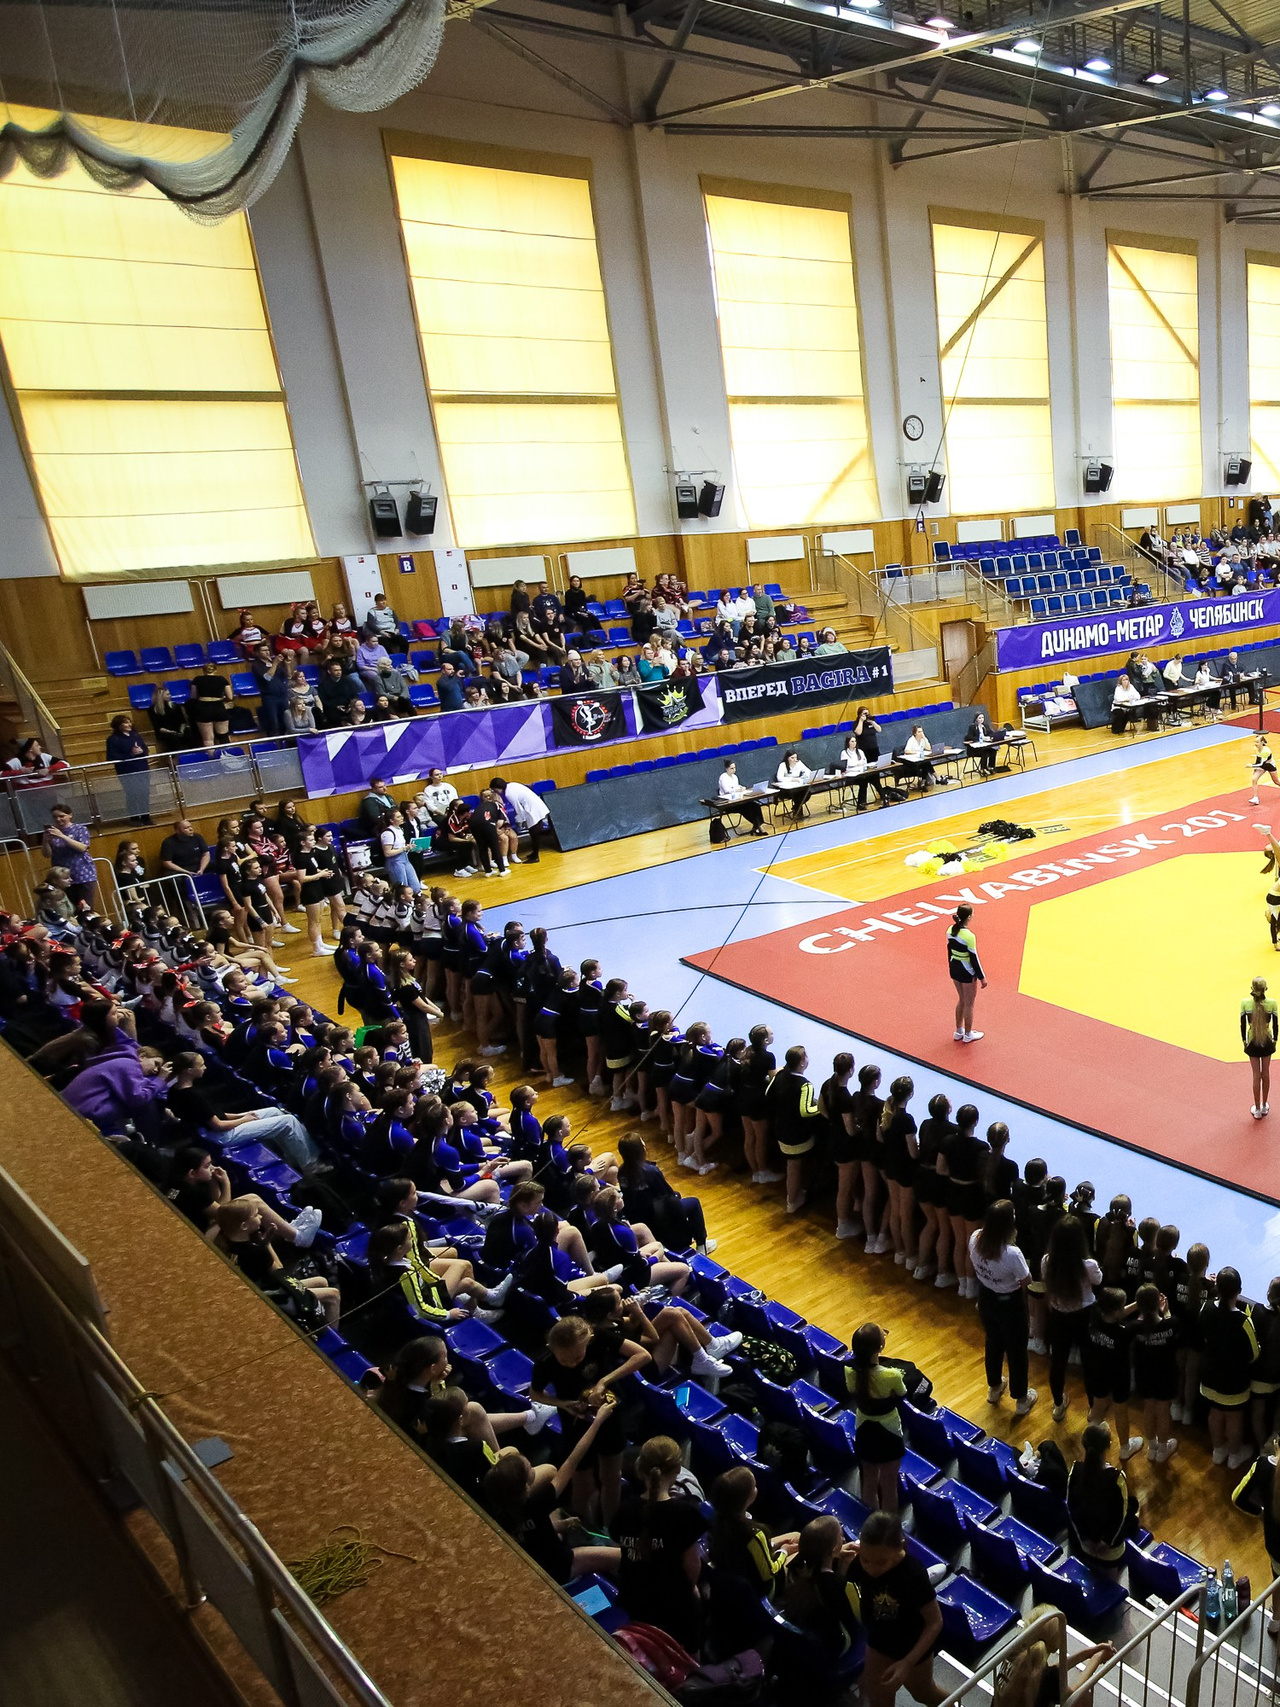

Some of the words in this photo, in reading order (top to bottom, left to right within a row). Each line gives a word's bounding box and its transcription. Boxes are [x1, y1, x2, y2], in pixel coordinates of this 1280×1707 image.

[403, 560, 412, 571] B
[1041, 613, 1164, 658] ДИНАМО-МЕТАР
[1189, 598, 1264, 630] ЧЕЛЯБИНСК
[725, 680, 788, 703] ВПЕРЕД
[791, 665, 871, 696] BAGIRA
[798, 831, 1177, 955] CHELYABINSK
